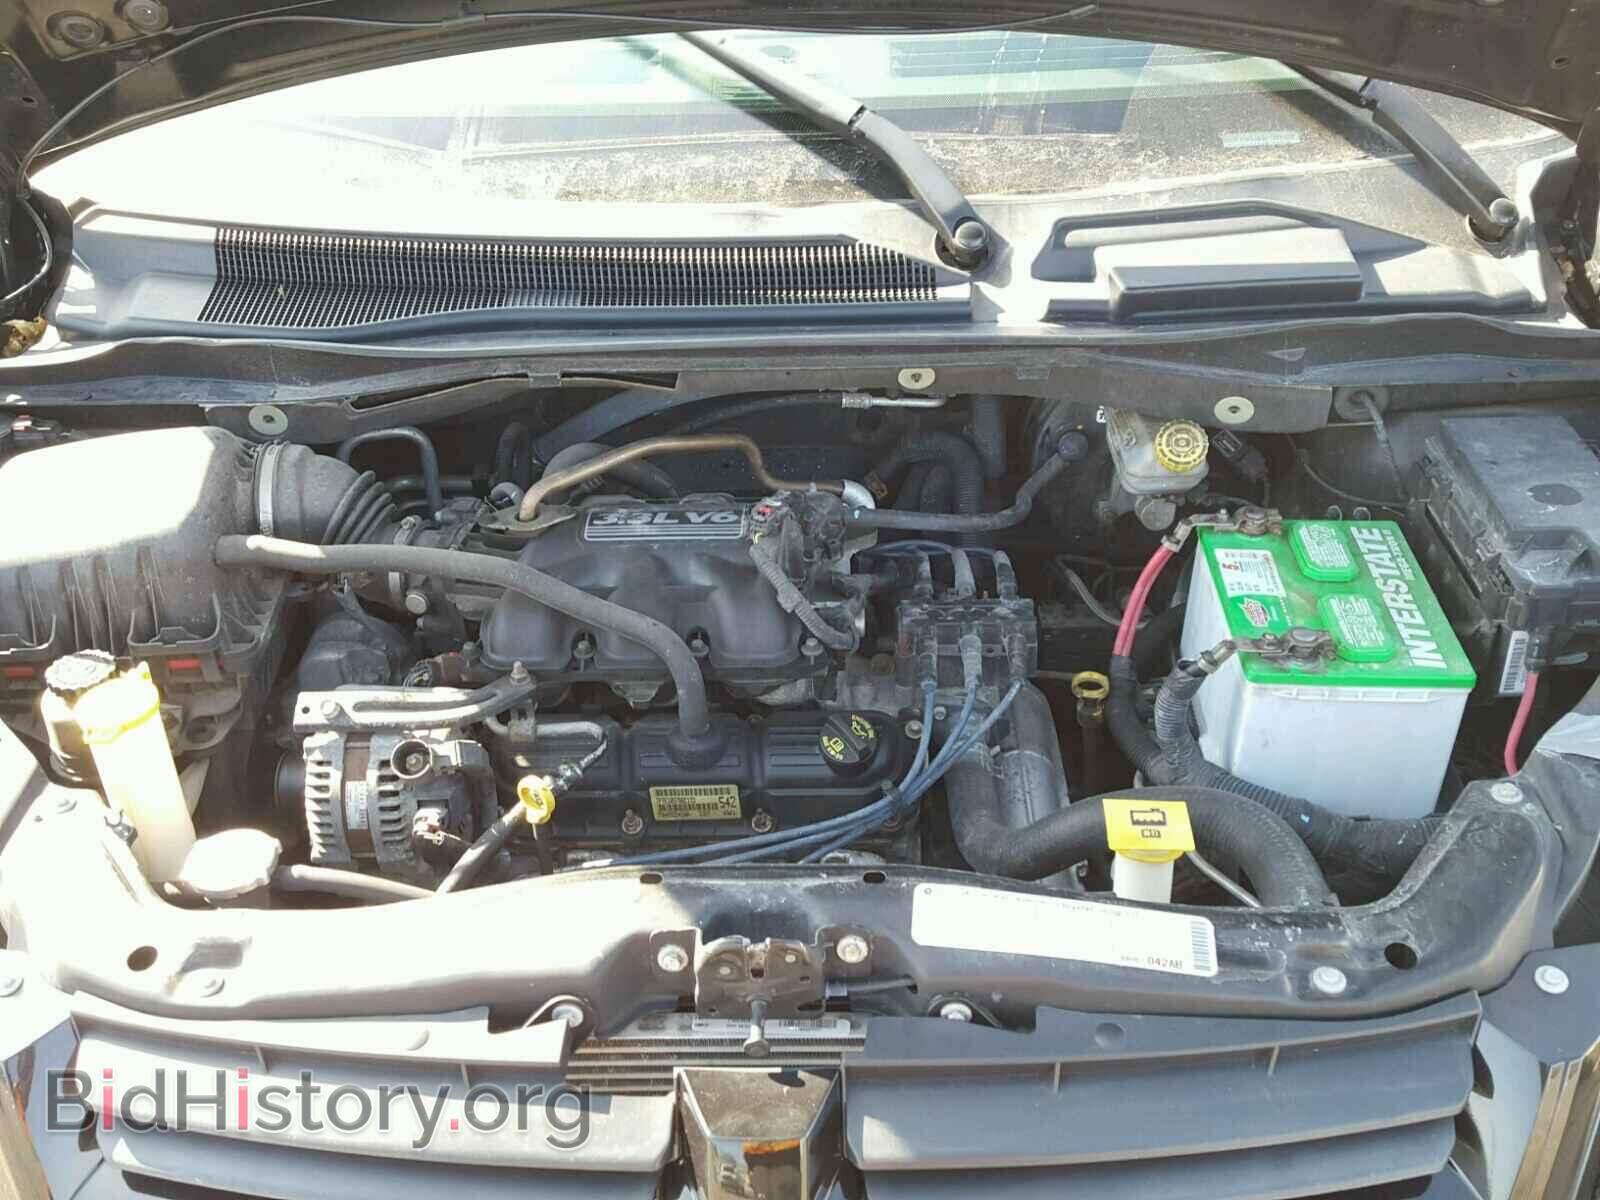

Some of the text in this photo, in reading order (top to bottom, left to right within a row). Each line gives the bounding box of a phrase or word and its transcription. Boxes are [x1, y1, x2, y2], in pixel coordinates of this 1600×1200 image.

[593, 511, 739, 525] 3.3L V6
[1350, 526, 1448, 670] INTERSTATE
